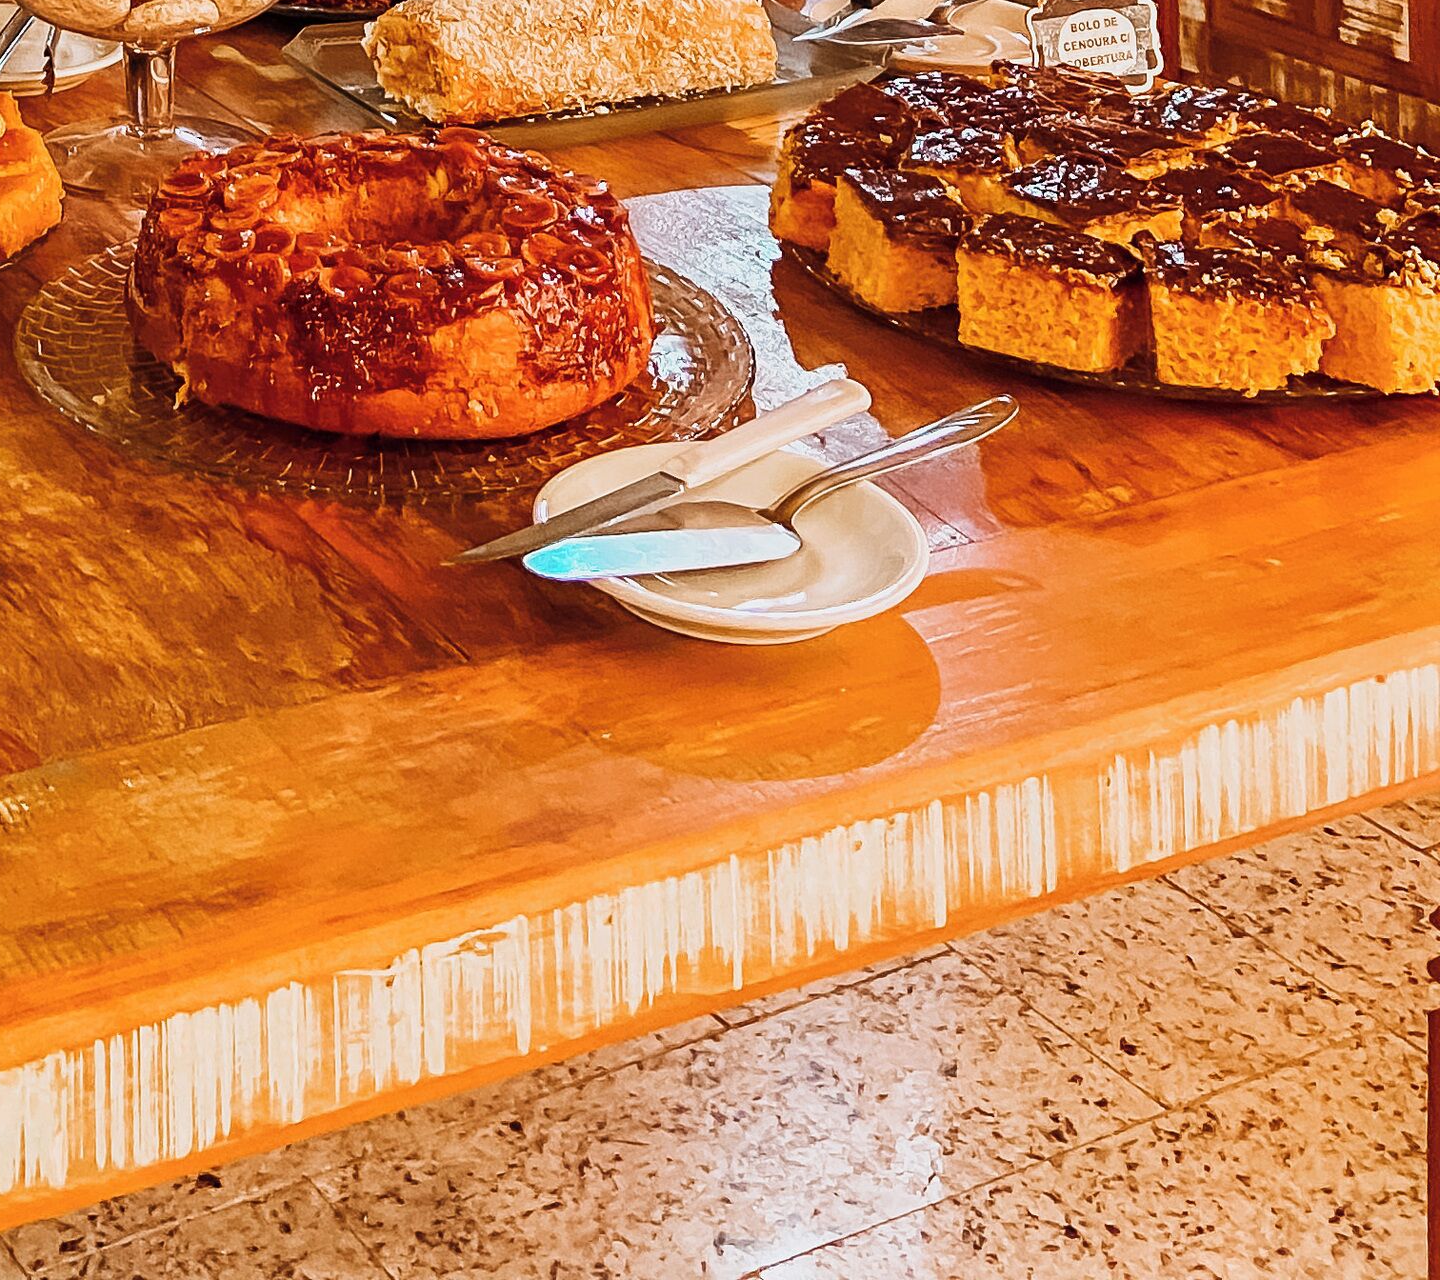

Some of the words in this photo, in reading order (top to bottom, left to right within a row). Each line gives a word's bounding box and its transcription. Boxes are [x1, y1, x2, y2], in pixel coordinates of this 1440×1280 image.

[1070, 20, 1101, 33] BOLO
[1103, 16, 1119, 28] DE
[1063, 35, 1118, 52] CENOURA
